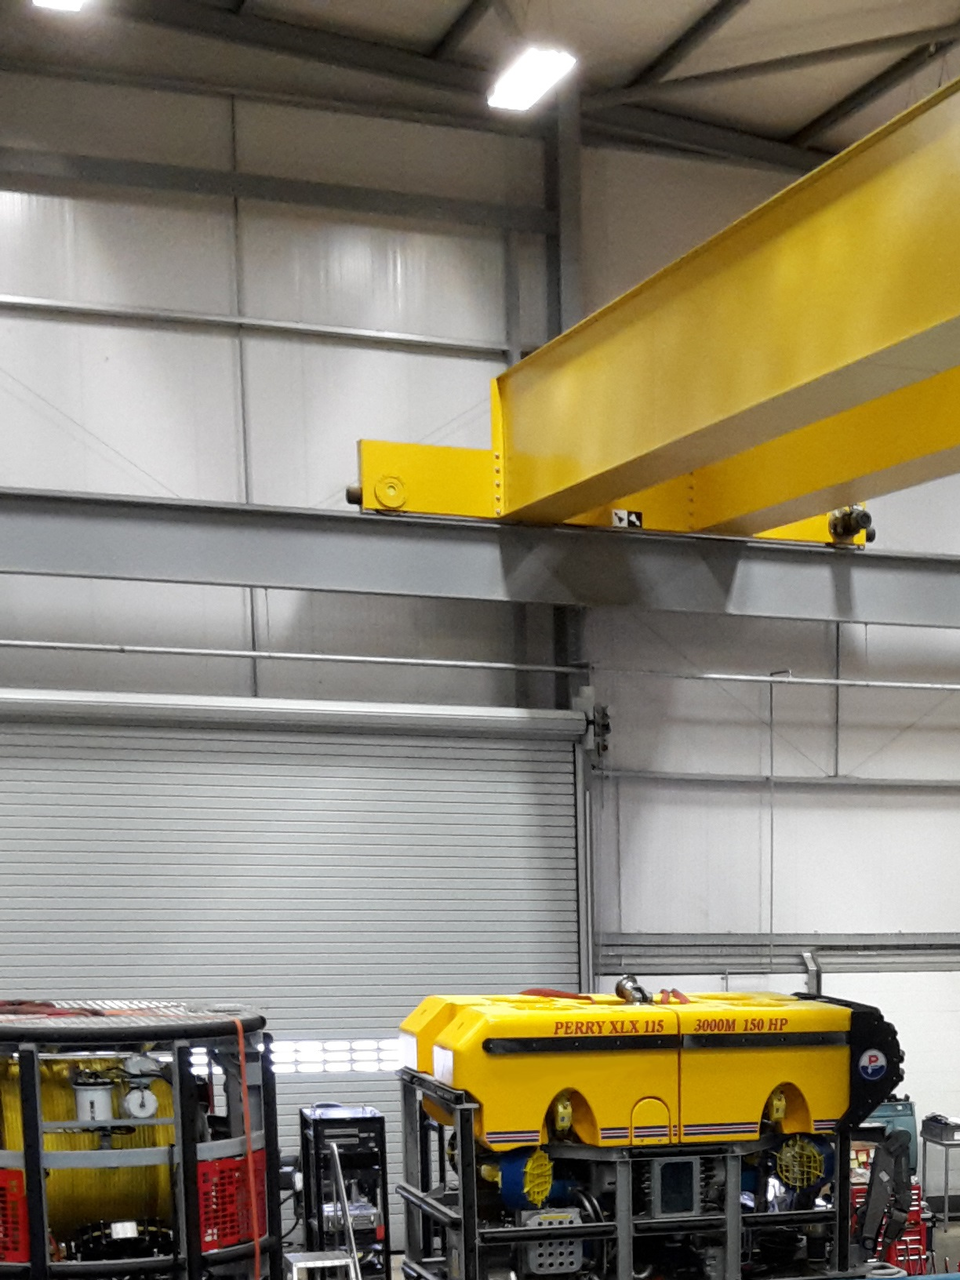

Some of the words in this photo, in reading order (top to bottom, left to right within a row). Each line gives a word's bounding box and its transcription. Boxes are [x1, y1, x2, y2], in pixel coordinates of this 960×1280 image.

[554, 1020, 606, 1035] PERRY
[609, 1020, 639, 1034] XLX
[644, 1019, 664, 1034] 115
[694, 1018, 737, 1033] 3000M
[743, 1018, 765, 1032] 150
[767, 1018, 788, 1032] HP
